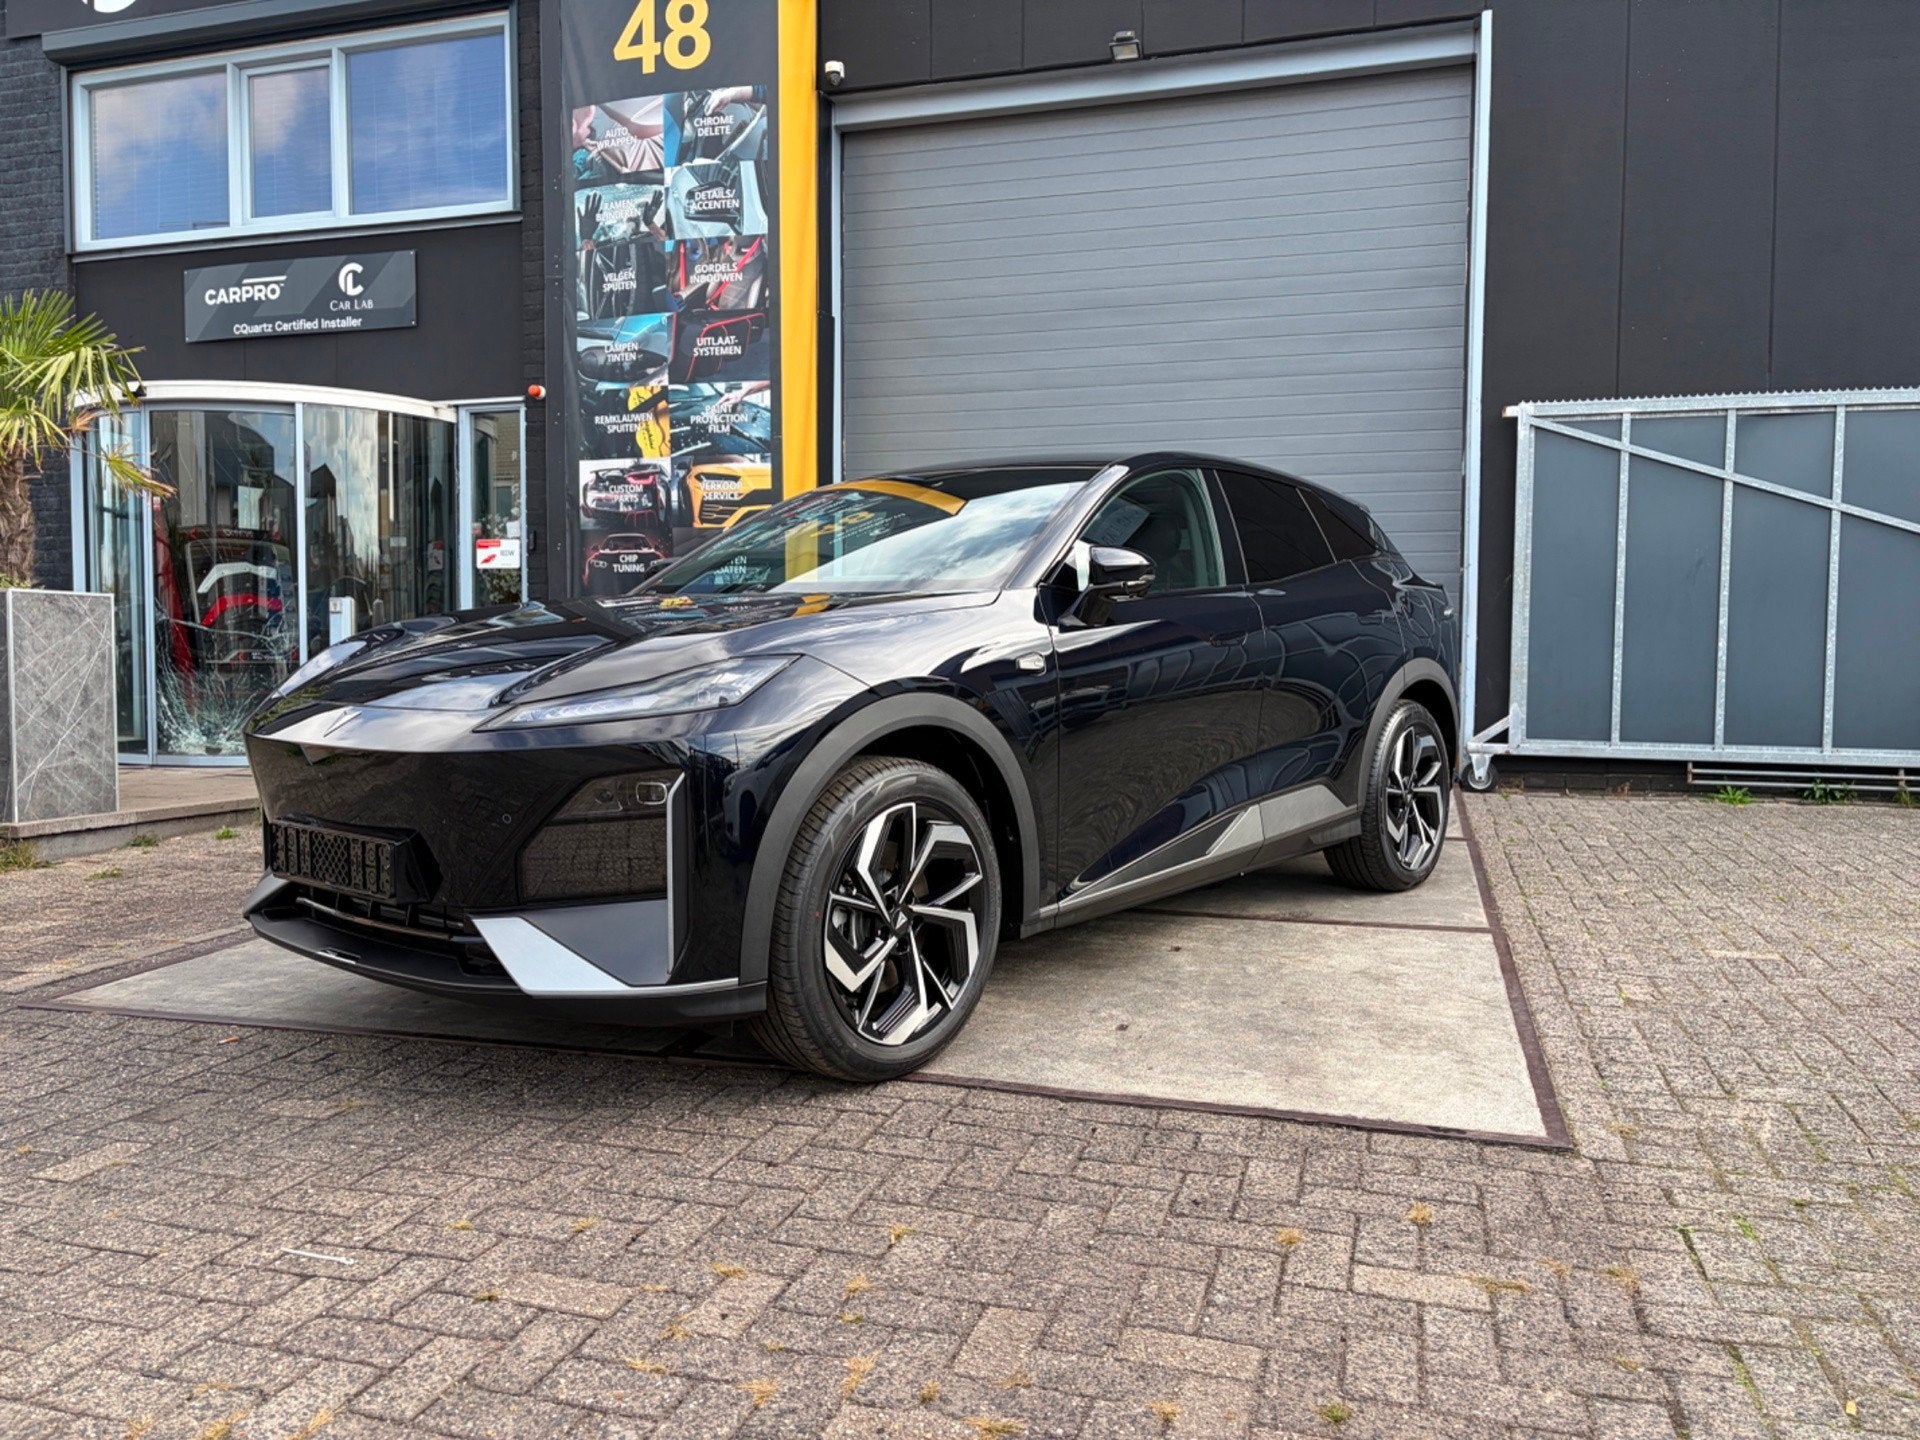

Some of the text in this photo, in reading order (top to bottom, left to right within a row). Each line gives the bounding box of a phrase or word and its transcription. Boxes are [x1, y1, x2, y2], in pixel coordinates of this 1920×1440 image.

[613, 0, 711, 74] 48
[693, 115, 735, 128] CHROME
[605, 127, 628, 139] AUTO
[697, 125, 731, 137] DELETE
[596, 135, 637, 149] WRAPPEN
[694, 189, 736, 200] DETAILS/
[691, 198, 740, 211] ACCENTEN
[694, 262, 738, 275] GORDELS
[603, 270, 636, 282] VELGEN
[690, 271, 743, 283] INBOUWEN
[233, 316, 363, 335] CQuartz Certified Installer
[697, 336, 739, 347] UITLAAT-
[604, 342, 639, 353] LAMPEN
[693, 345, 742, 357] SYSTEMEN
[607, 352, 637, 362] TINTEN
[705, 404, 733, 414] PAINT
[594, 412, 653, 424] REMKLAUWEN
[690, 412, 748, 424] PROTECTION
[607, 423, 641, 434] SPUITEN
[708, 424, 731, 434] FILM
[608, 484, 644, 494] CUSTOM
[701, 480, 743, 491] VERKOOP
[612, 493, 639, 503] PARTS
[703, 491, 739, 501] SERVICE
[619, 555, 638, 564] CHIP
[612, 563, 645, 573] TUNING
